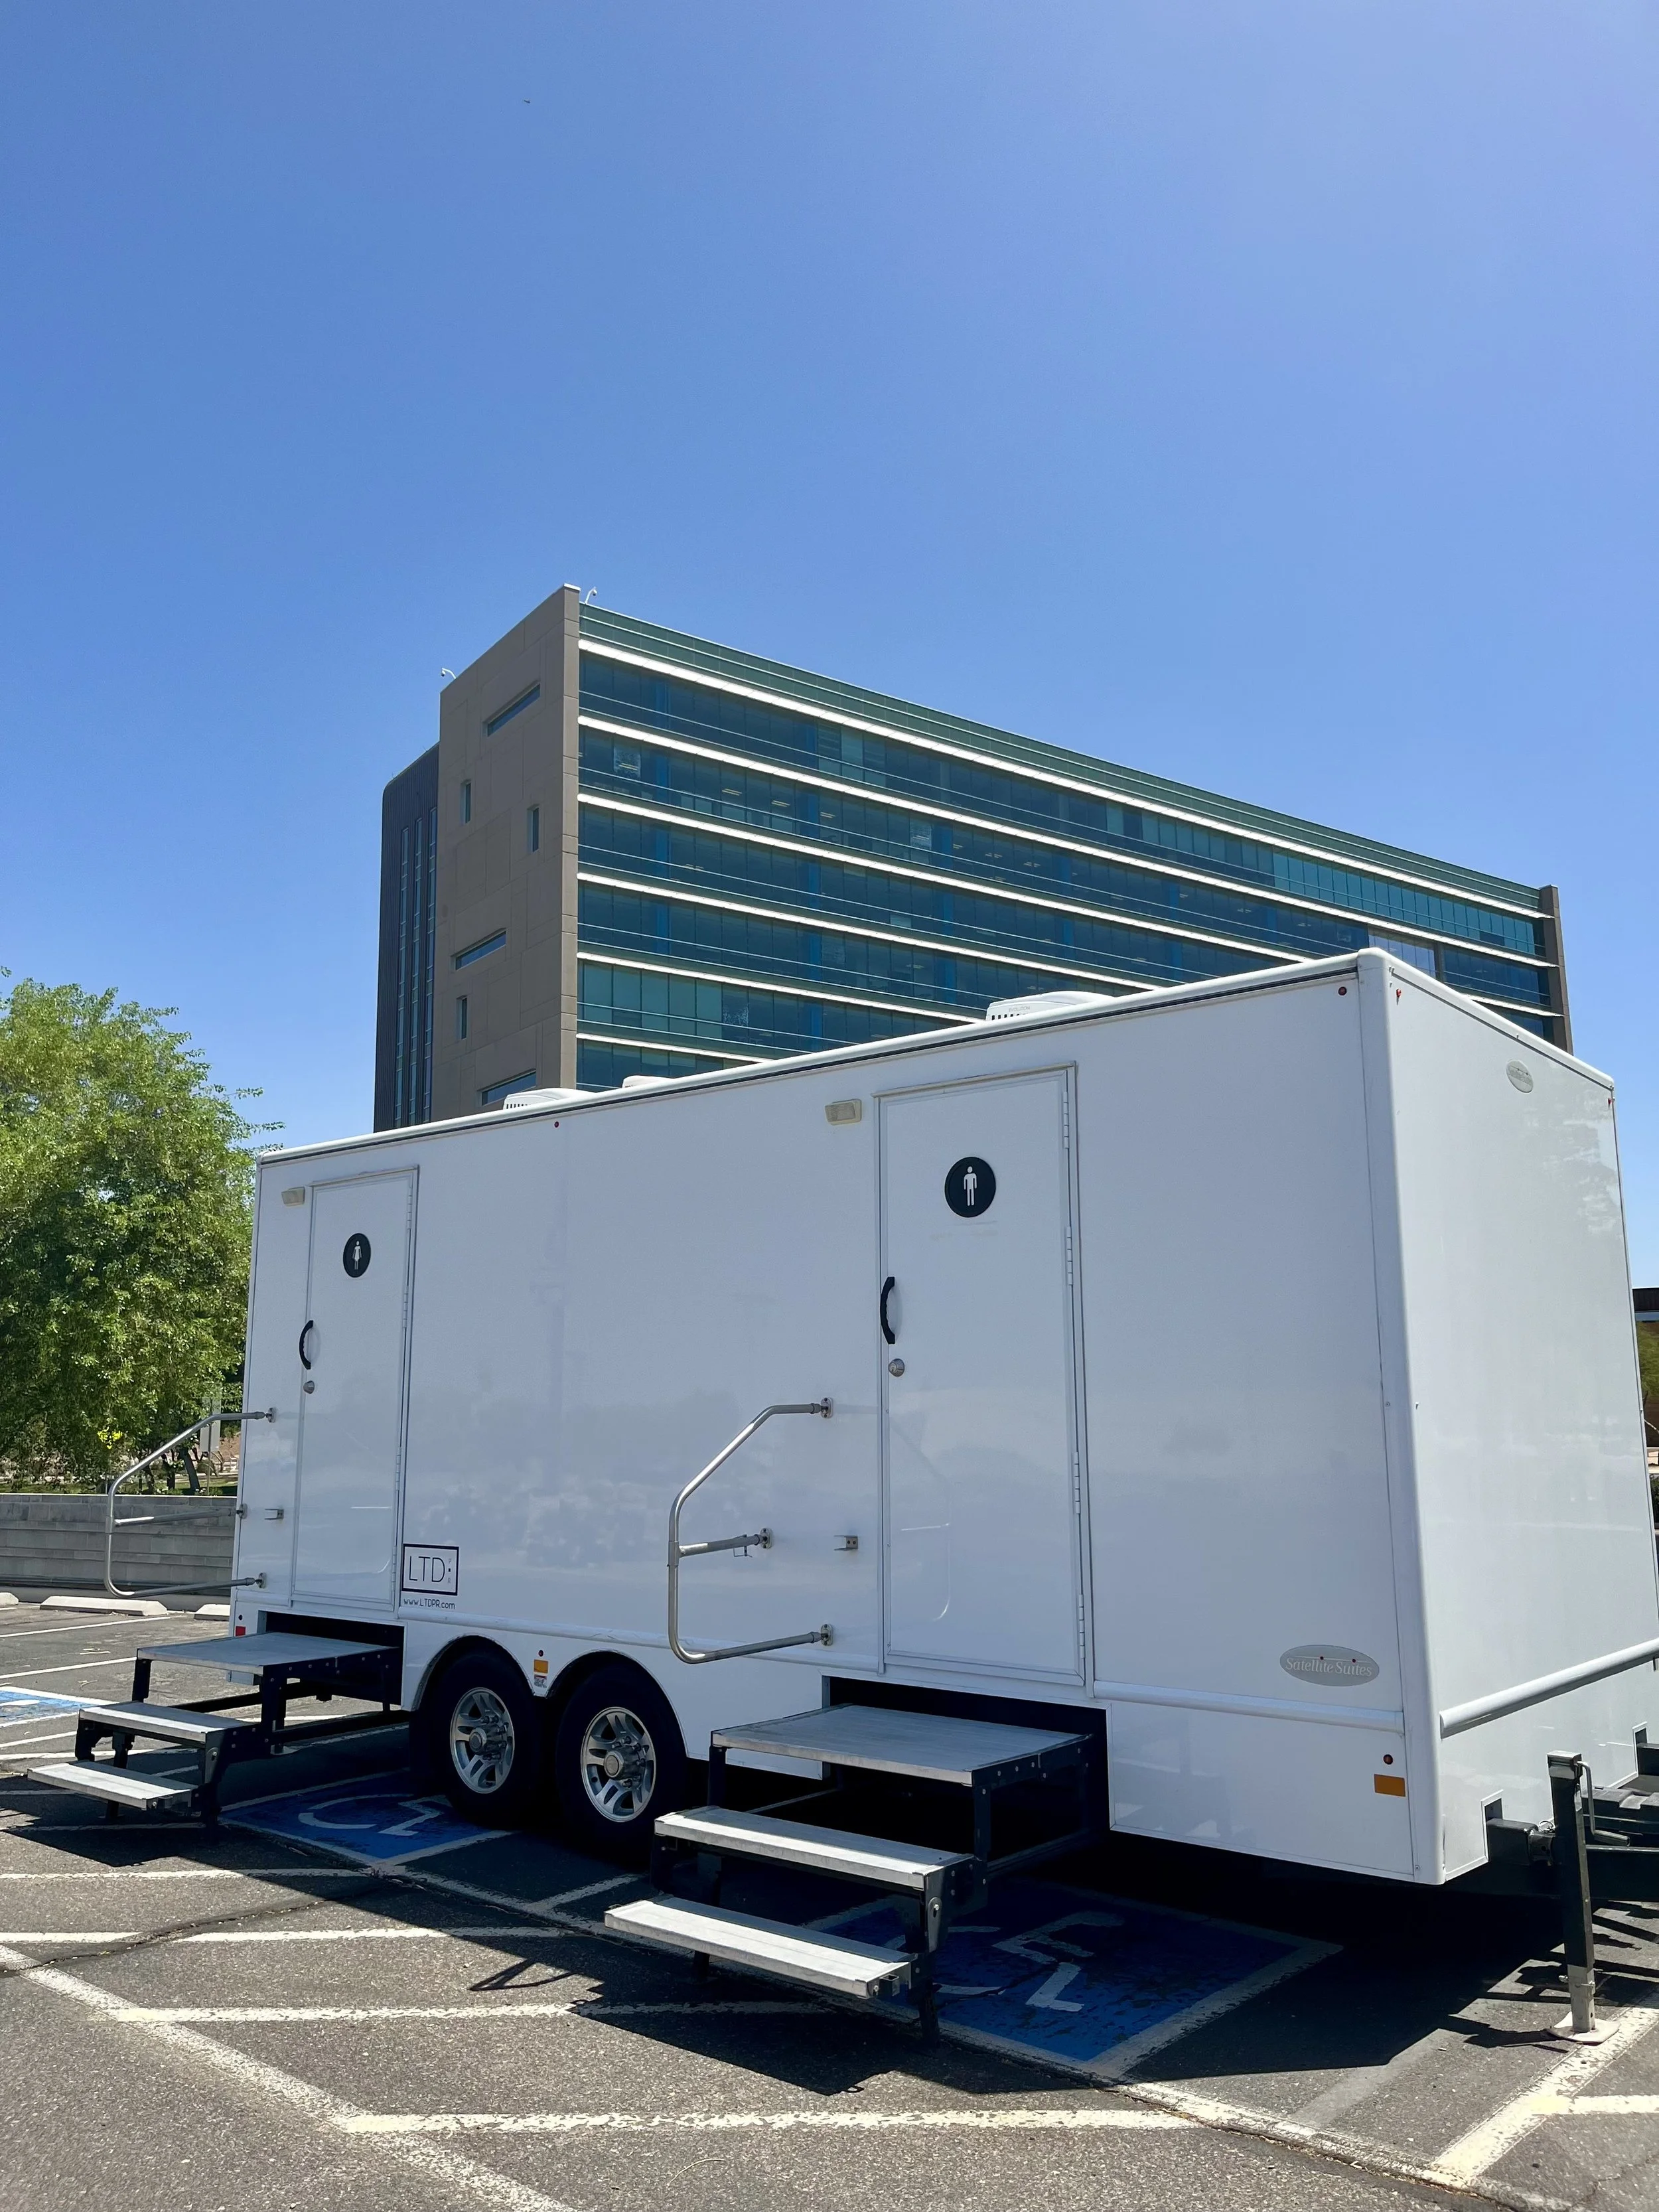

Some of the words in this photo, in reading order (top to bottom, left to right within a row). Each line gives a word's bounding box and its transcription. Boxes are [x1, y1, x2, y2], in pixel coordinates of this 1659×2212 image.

[403, 1598, 455, 1609] www.LTDPR.com
[1285, 1657, 1334, 1673] Satellite
[1336, 1659, 1372, 1677] Suites
